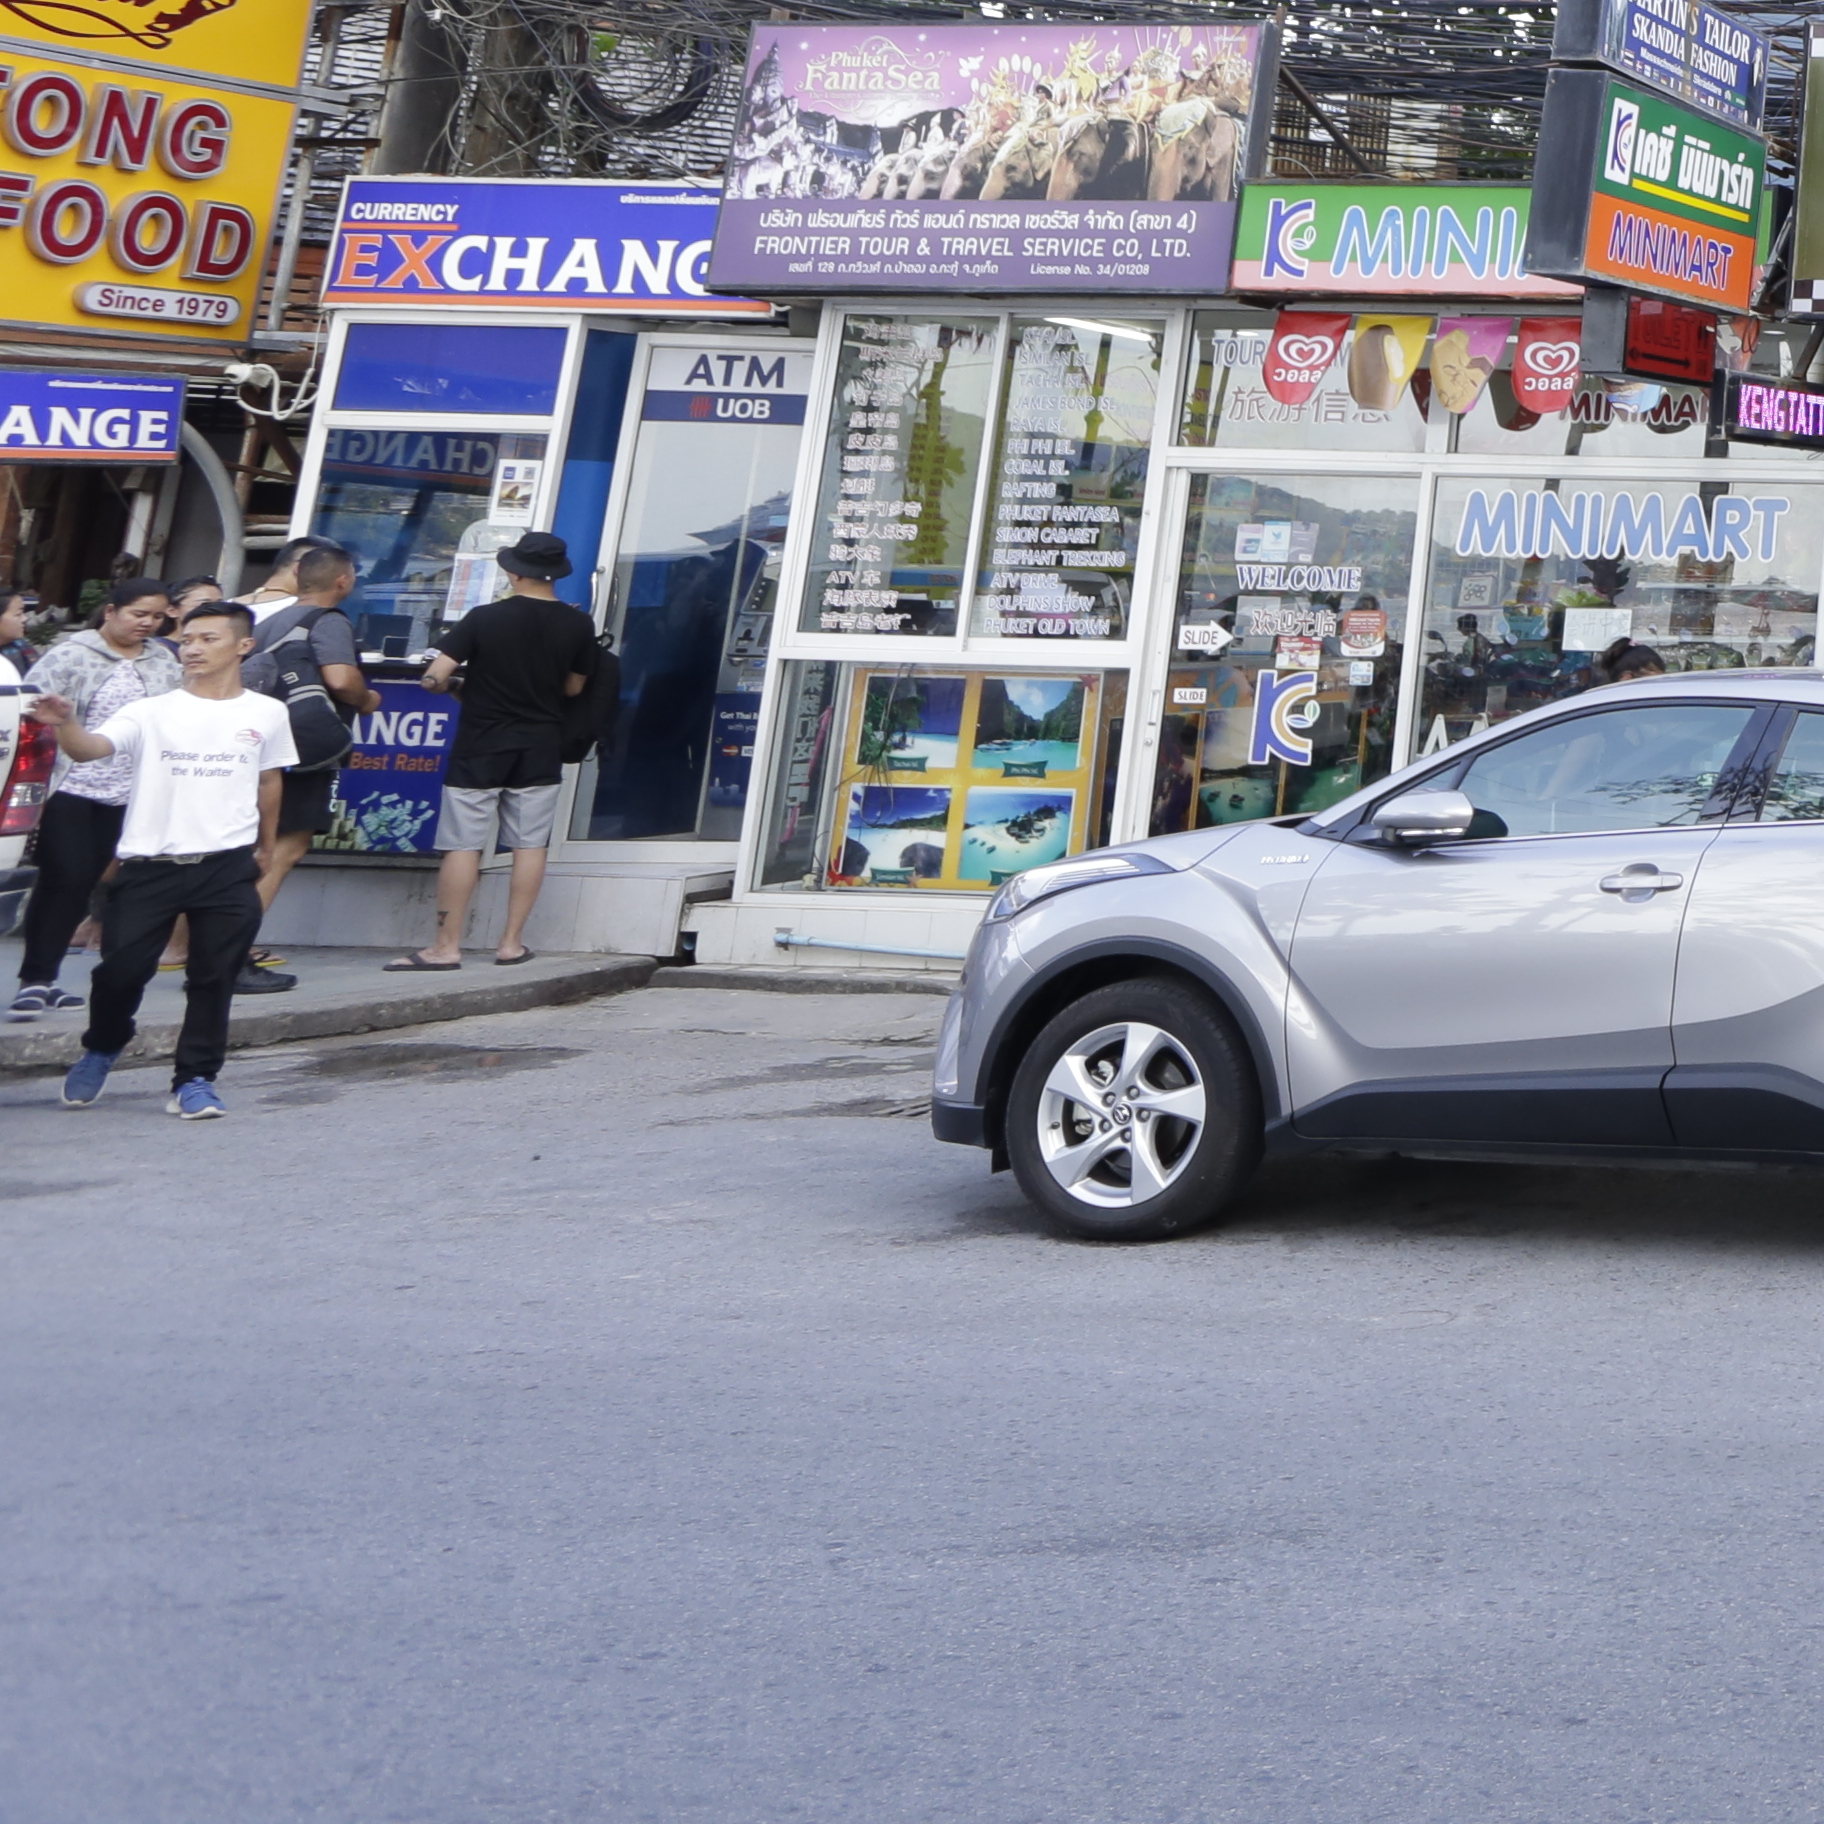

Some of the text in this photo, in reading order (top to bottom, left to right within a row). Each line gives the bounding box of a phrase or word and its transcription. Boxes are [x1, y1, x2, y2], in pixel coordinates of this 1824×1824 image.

[1704, 13, 1750, 65] TAILOR
[829, 50, 888, 67] Phuket
[1632, 12, 1738, 88] SKANDIA FASHION
[0, 66, 232, 179] ONG
[1634, 123, 1754, 210] เคซี มินิมาร์ท
[350, 201, 460, 224] CURRENCY
[759, 209, 801, 228] บริษัท
[890, 209, 920, 229] ทัวร์
[924, 210, 964, 229] แอนด์
[1084, 210, 1124, 230] จำกัด
[754, 236, 850, 256] FRONTIER
[859, 237, 908, 256] TOUR
[916, 237, 931, 256] &
[940, 237, 1013, 257] TRAVEL
[1022, 238, 1107, 257] SERVICE
[1151, 238, 1192, 258] LTD.
[1608, 209, 1734, 292] MINIMART
[817, 261, 1150, 277] 128 License No. 34/01208
[98, 288, 228, 319] Since 1979
[685, 353, 786, 389] ATM
[716, 397, 771, 419] UOB
[1014, 396, 1096, 410] JAMES BOND
[0, 405, 169, 448] ANGE
[1009, 417, 1045, 432] RAYA
[1007, 438, 1053, 455] PHI PHI
[1004, 459, 1047, 476] CORAL
[1002, 481, 1056, 499] RAFTING
[998, 504, 1120, 523] PHUKET FANTASEA
[995, 526, 1100, 544] SIMON CABARET
[1456, 489, 1792, 564] MINIMART
[992, 548, 1126, 567] ELEPHANT TREKKING
[826, 570, 859, 584] ATV
[990, 572, 1059, 589] ATV DRIVE
[1235, 564, 1362, 592] WELCOME
[987, 594, 1096, 612] DOLPHINS SHOW
[983, 617, 1111, 636] PHUKET OLD TOWN
[1250, 608, 1338, 637] 欢迎光临
[1183, 629, 1219, 646] SLIDE
[161, 749, 235, 763] Please order
[351, 752, 440, 772] Best Rate!
[171, 766, 234, 778] the Waiter
